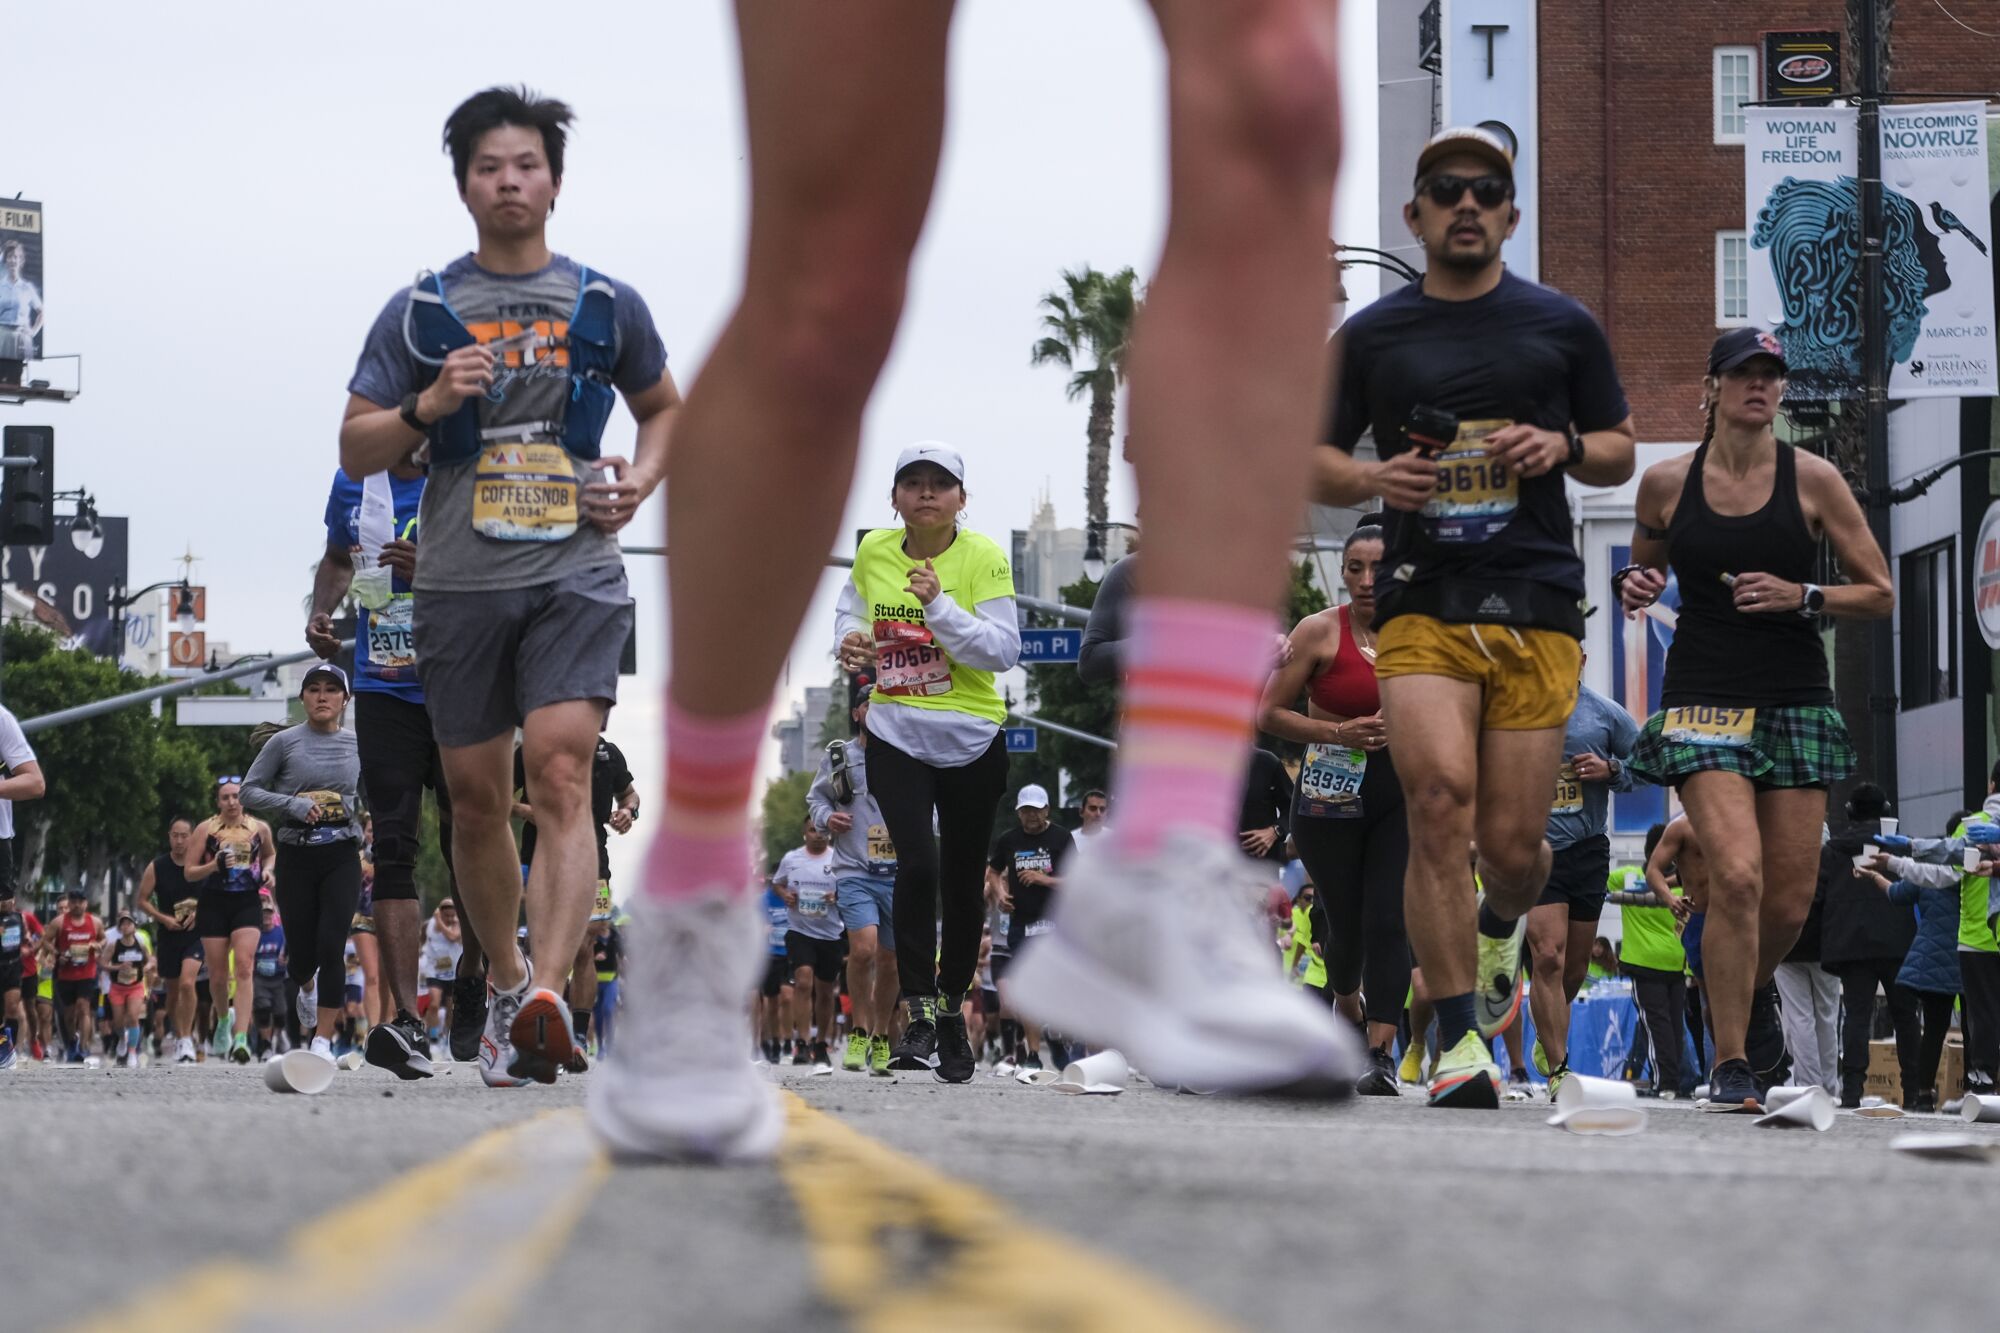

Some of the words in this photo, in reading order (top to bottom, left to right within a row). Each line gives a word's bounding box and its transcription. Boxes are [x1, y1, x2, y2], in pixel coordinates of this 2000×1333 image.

[1766, 121, 1836, 134] WOMAN
[1881, 114, 1978, 130] WELCOMING
[1786, 136, 1817, 148] LIFE
[1884, 129, 1978, 149] NOWRUZ
[1762, 150, 1841, 163] FREEDOM
[1884, 150, 1925, 160] IRANIAN
[1927, 149, 1951, 158] NEW
[1952, 147, 1980, 157] YEAR
[5, 211, 33, 229] FILM
[498, 303, 550, 318] TEAM
[1926, 327, 1971, 338] MARCH
[1973, 326, 1988, 337] 20
[1927, 360, 1988, 371] FARHANG
[482, 485, 569, 506] COFFEESNOB
[874, 603, 925, 619] Studen
[1051, 638, 1069, 654] Pl
[1675, 705, 1745, 727] 11057
[1303, 766, 1358, 794] 23936
